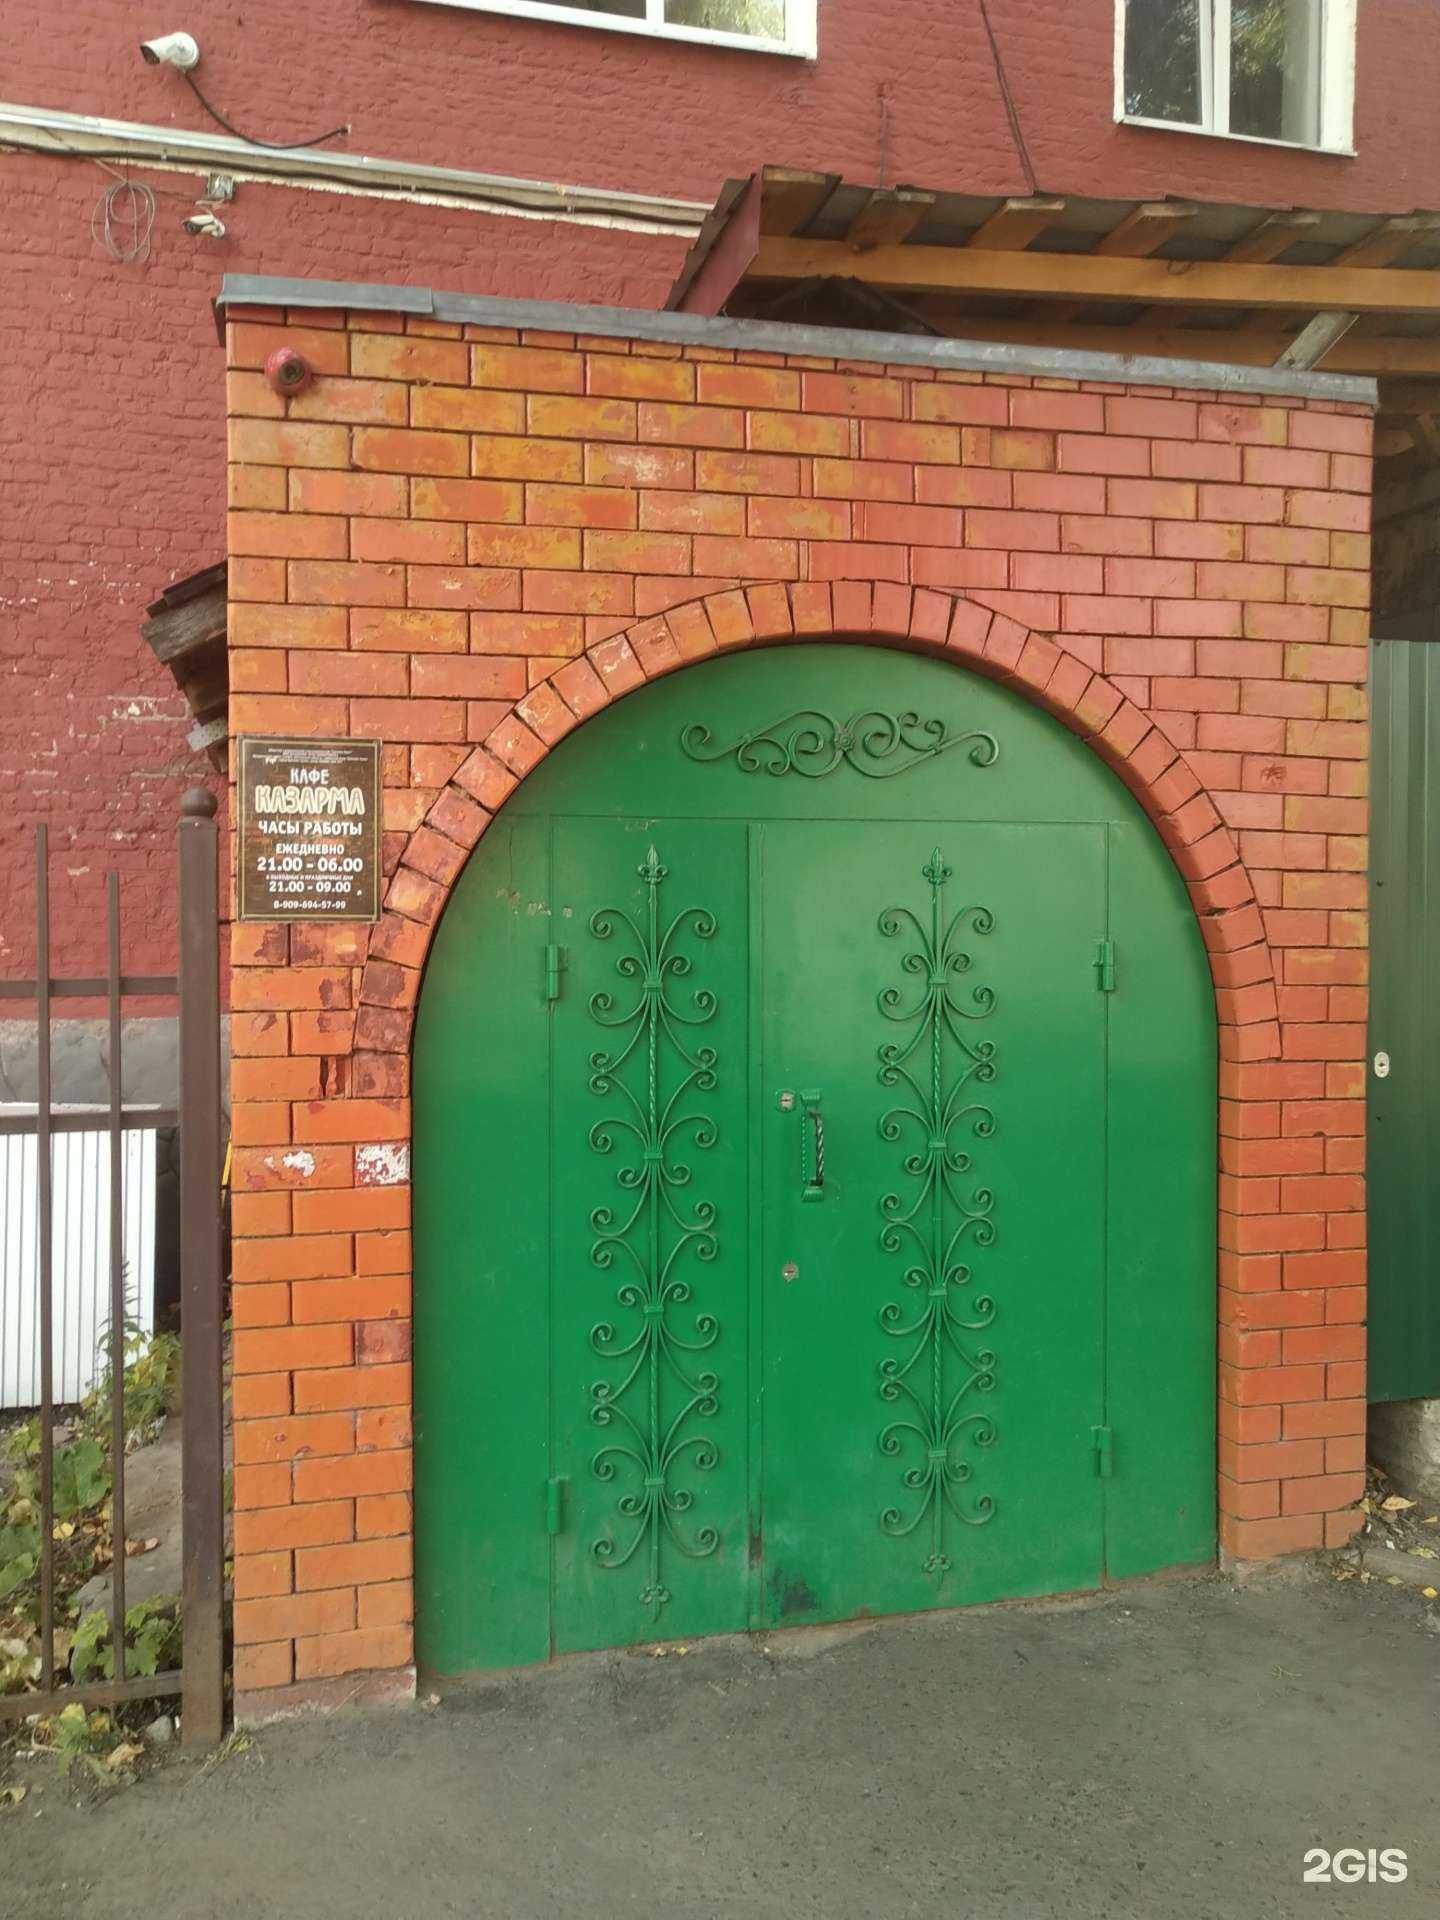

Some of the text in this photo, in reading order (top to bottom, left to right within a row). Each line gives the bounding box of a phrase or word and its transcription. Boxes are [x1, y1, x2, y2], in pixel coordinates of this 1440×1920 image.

[290, 768, 330, 784] КАФЕ
[255, 785, 366, 815] КАЗАРМА
[258, 820, 363, 835] ЧАСЫ РАБОТЫ
[275, 843, 345, 856] ЕЖЕДНЕВНО
[257, 857, 303, 872] 21.00
[317, 858, 363, 872] 06.00
[269, 881, 305, 893] 21.00
[315, 881, 352, 893] 09.00
